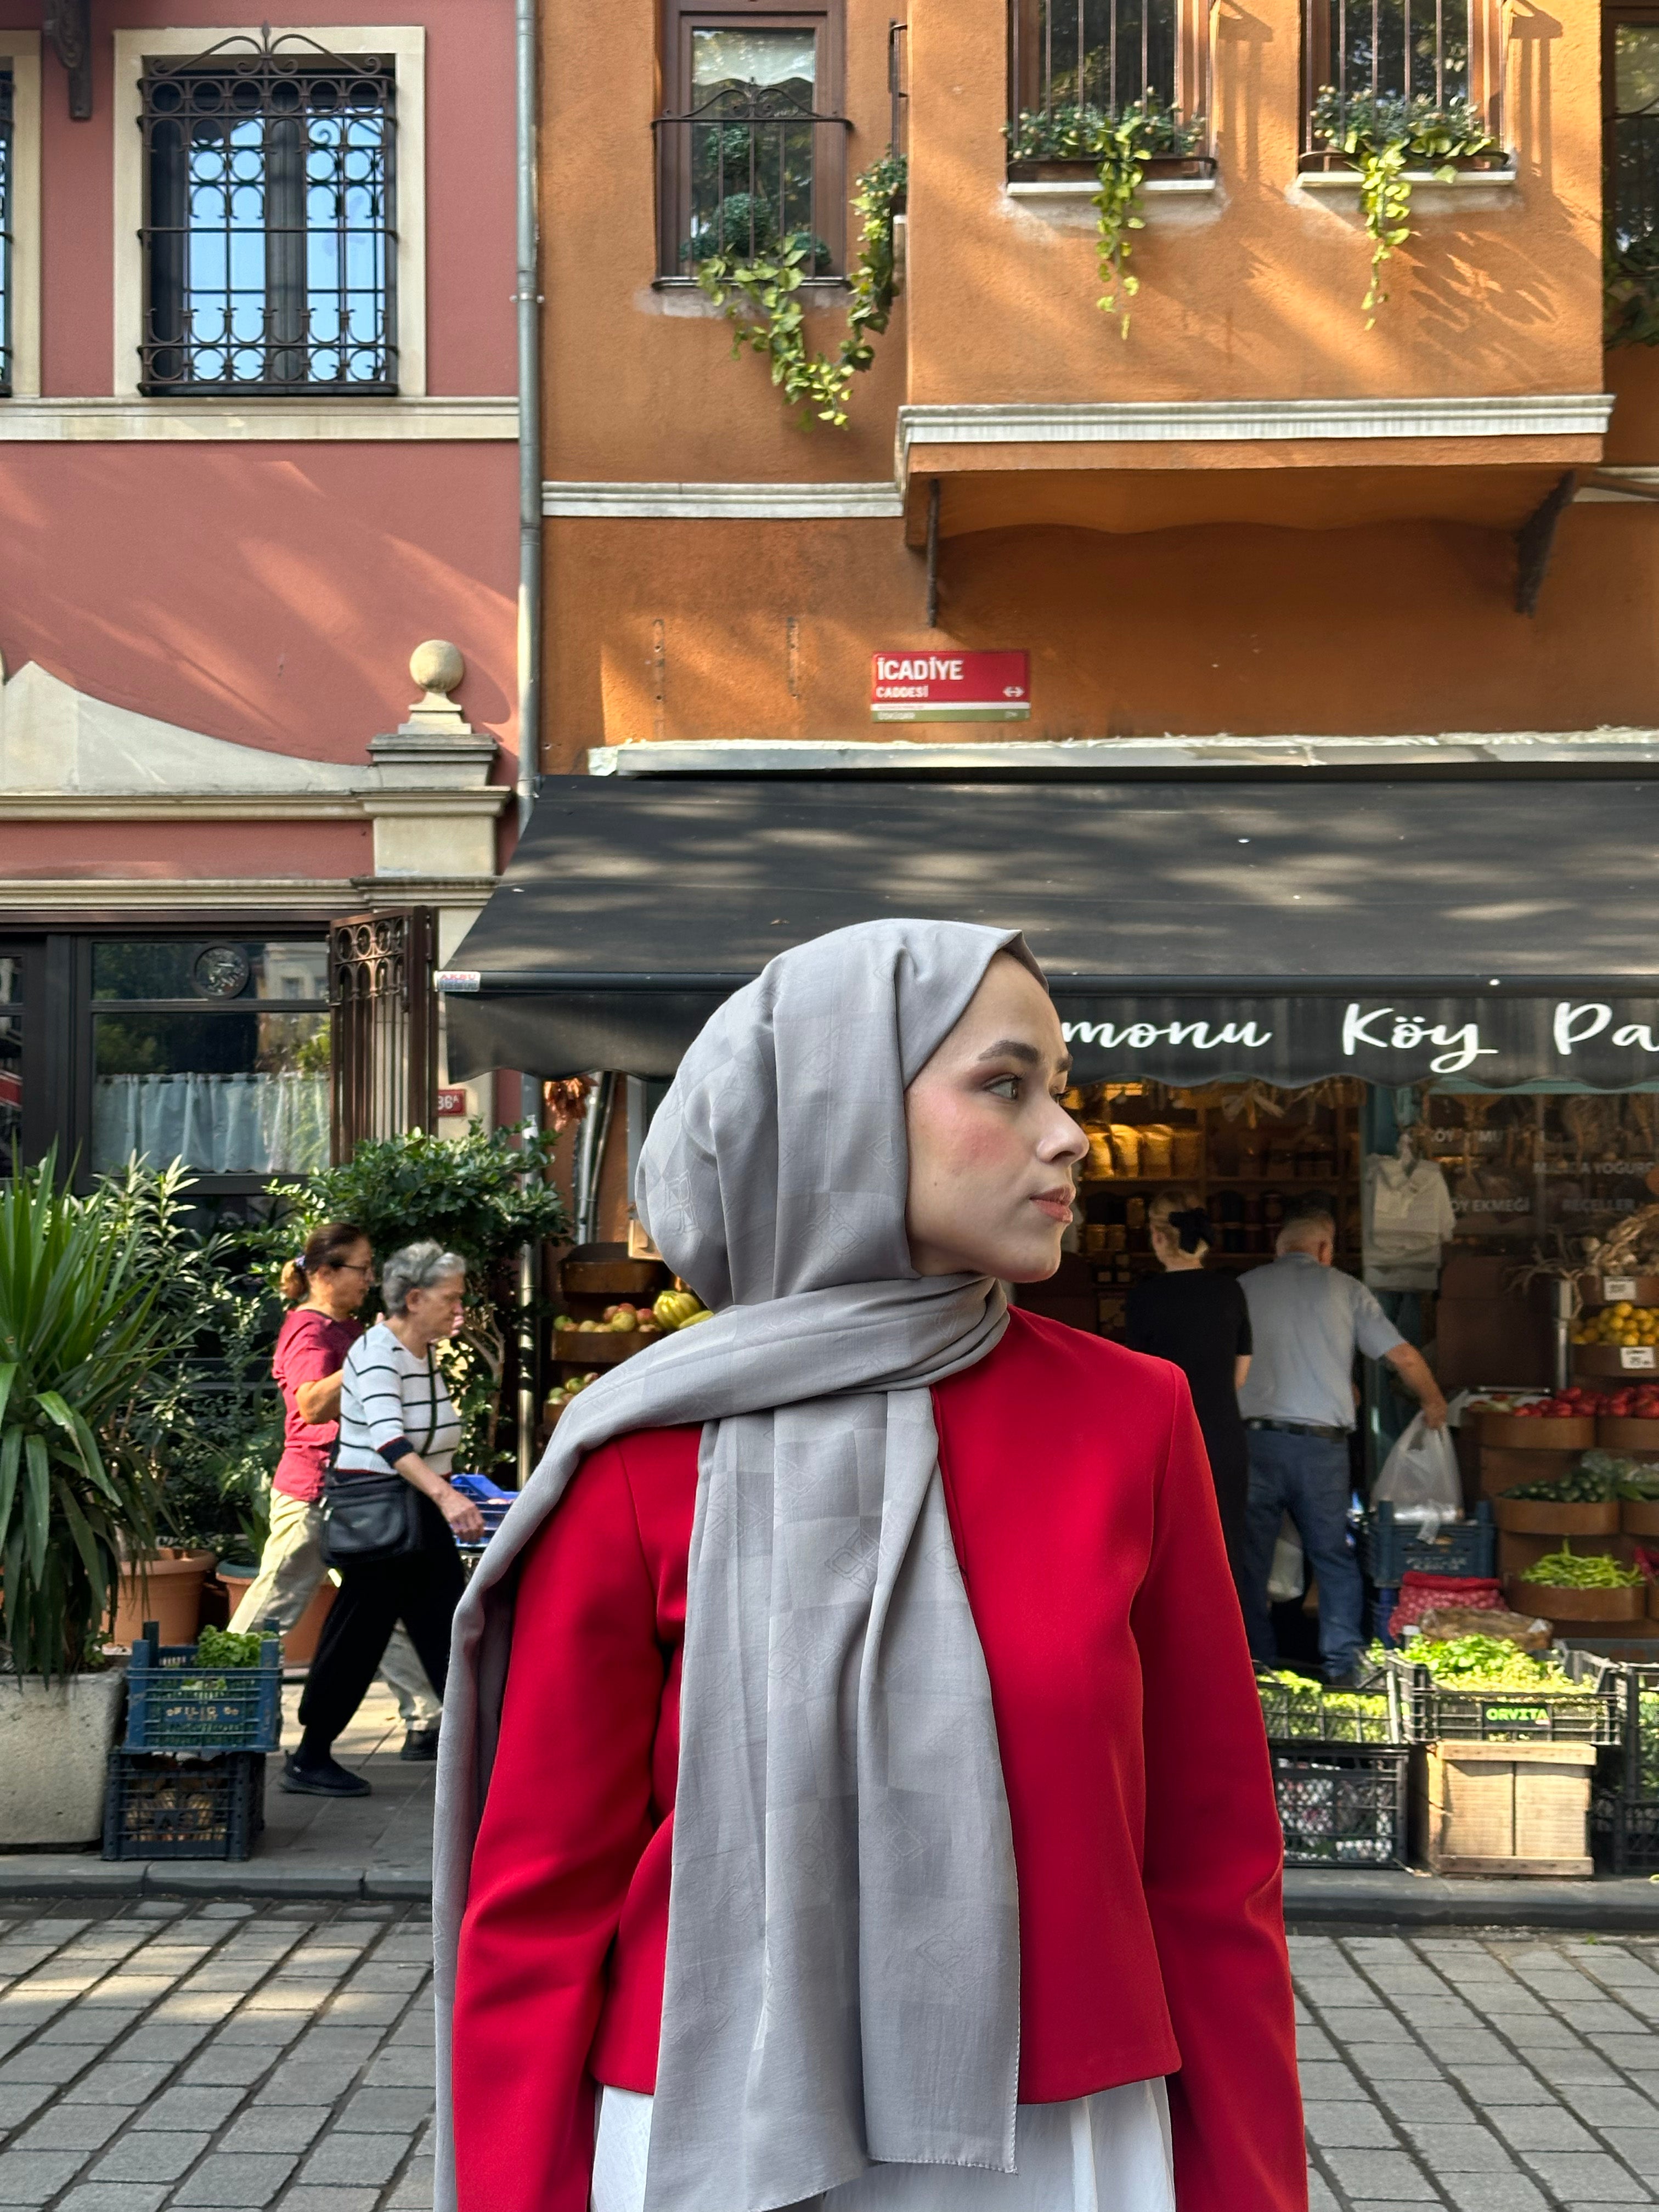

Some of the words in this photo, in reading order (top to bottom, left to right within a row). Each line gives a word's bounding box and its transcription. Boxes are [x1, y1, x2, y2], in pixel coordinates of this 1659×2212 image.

[877, 657, 964, 680] İCADİYE
[876, 685, 928, 698] CADDESİ
[1342, 1003, 1499, 1073] Köy
